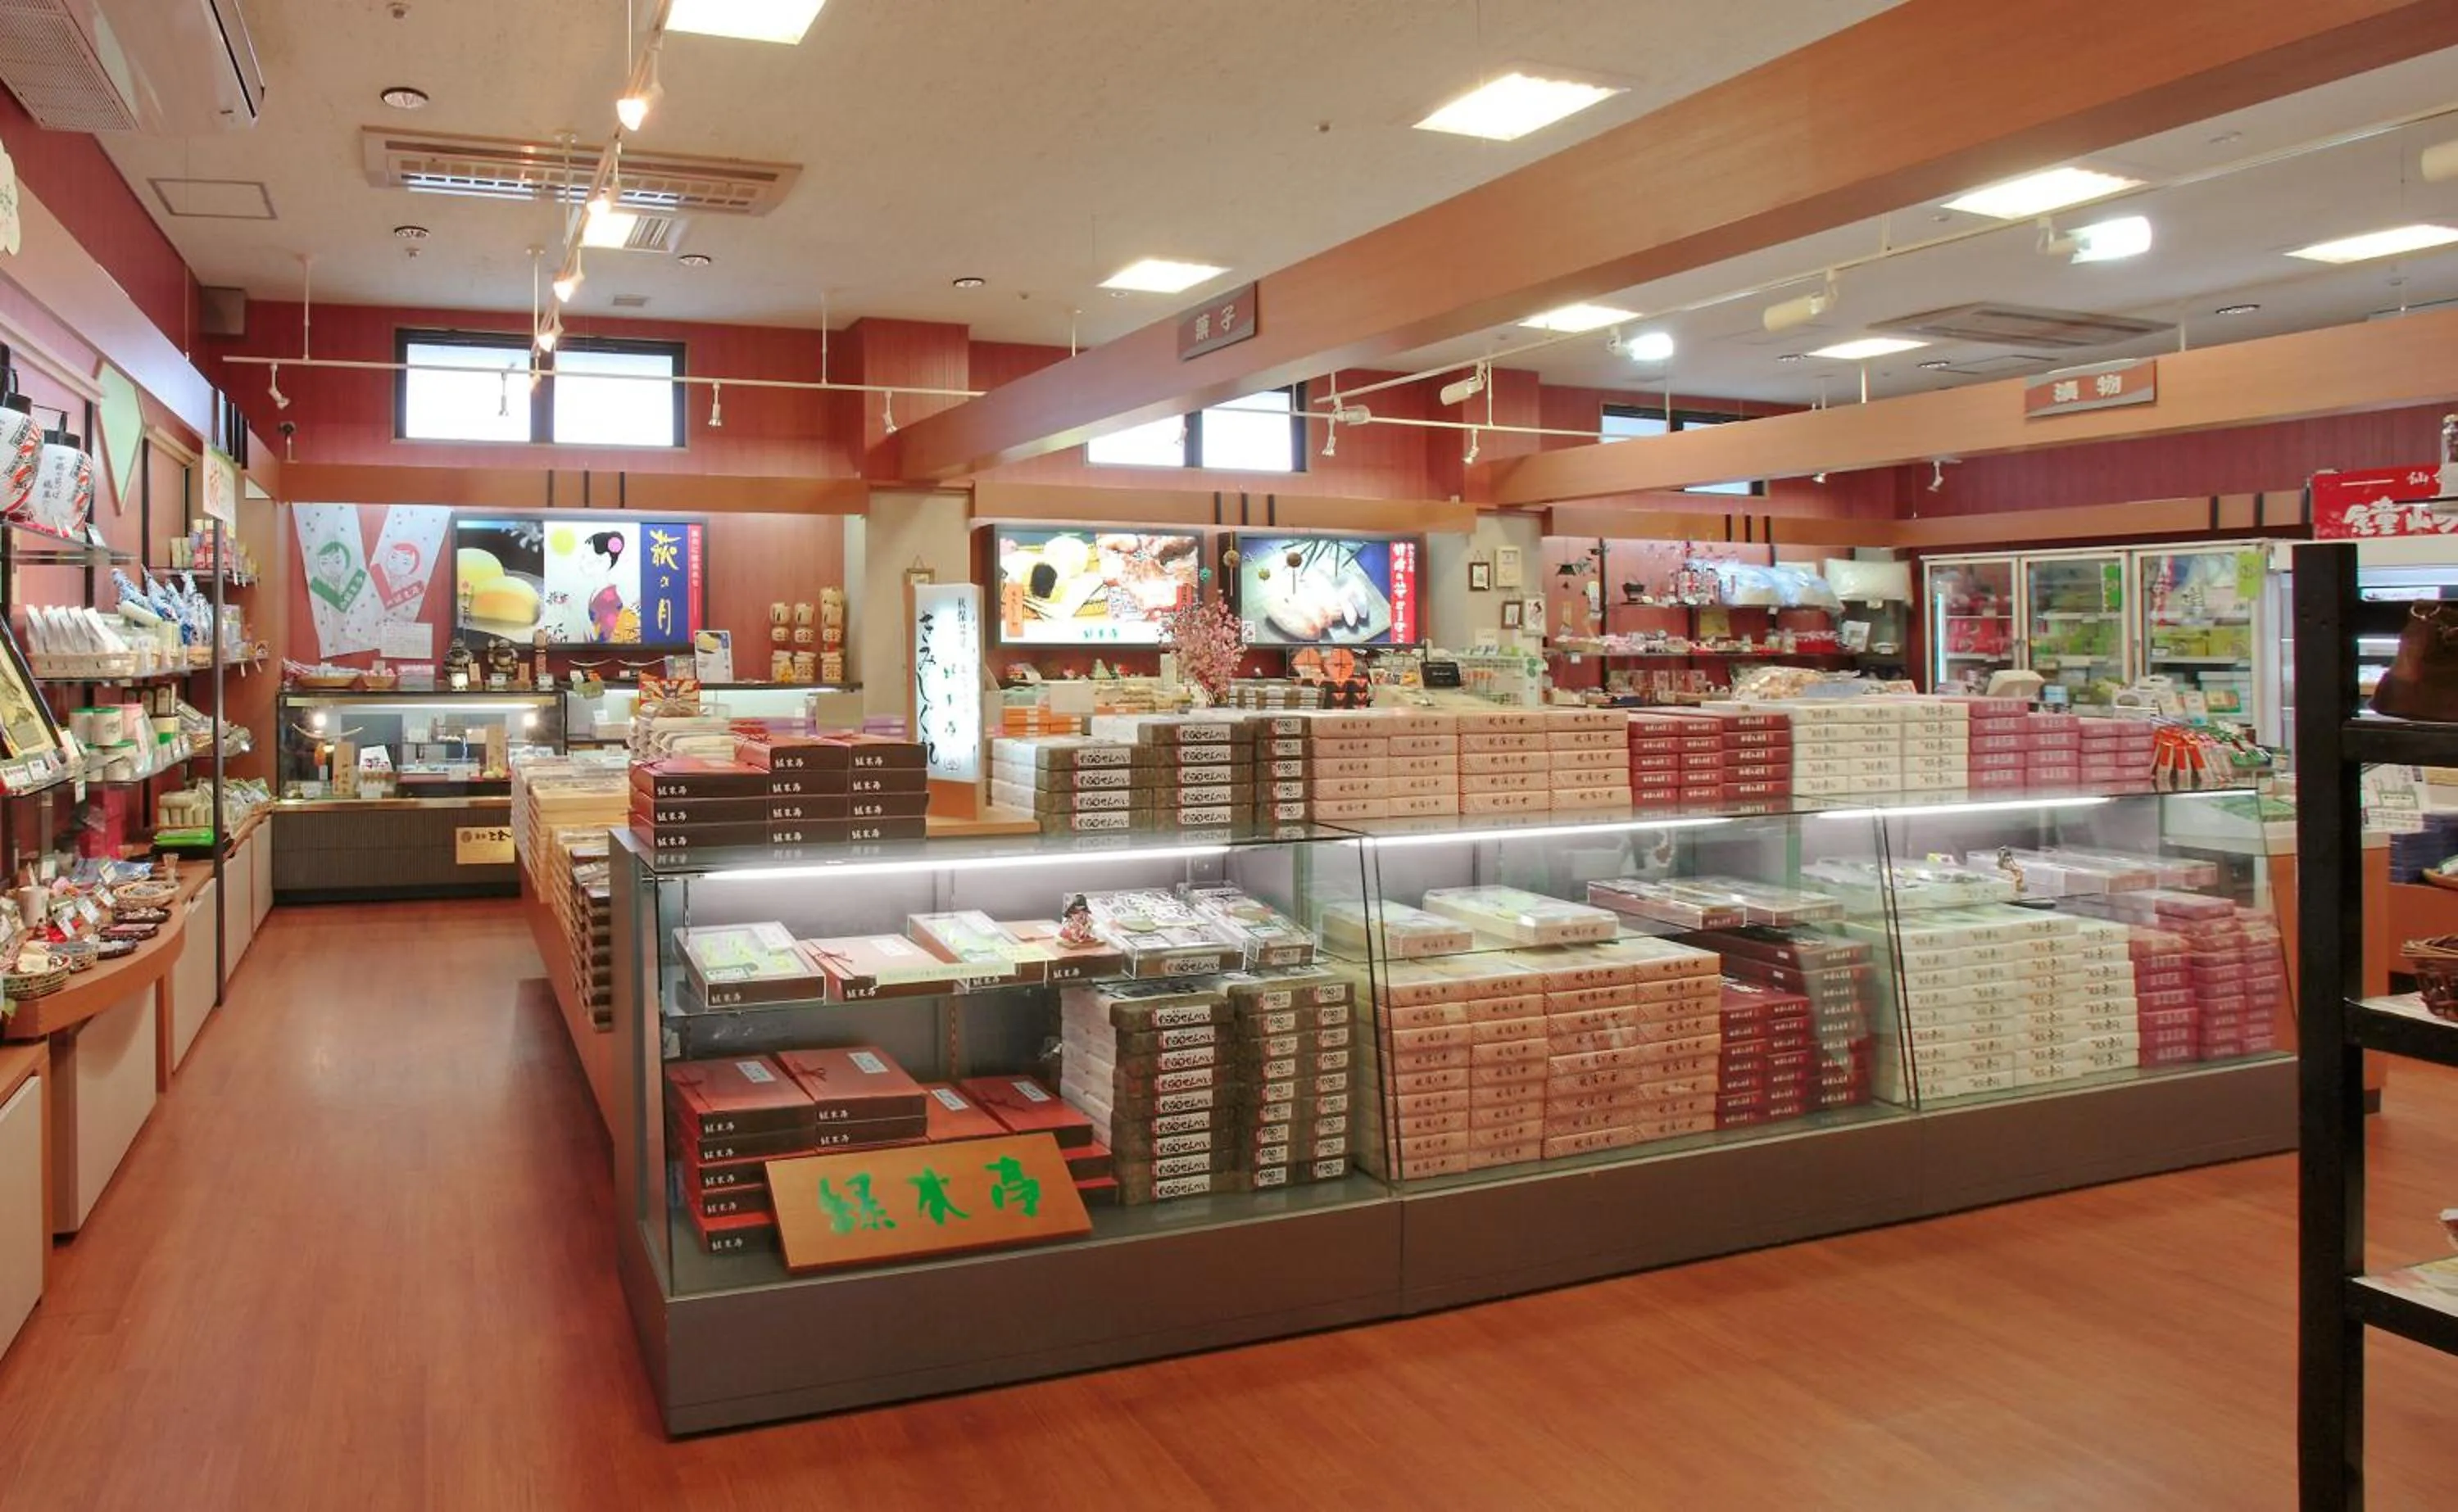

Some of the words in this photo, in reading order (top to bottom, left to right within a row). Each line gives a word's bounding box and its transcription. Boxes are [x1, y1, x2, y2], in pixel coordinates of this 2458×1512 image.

[649, 530, 682, 636] 萩の月
[821, 1156, 1041, 1235] 緑水亭
